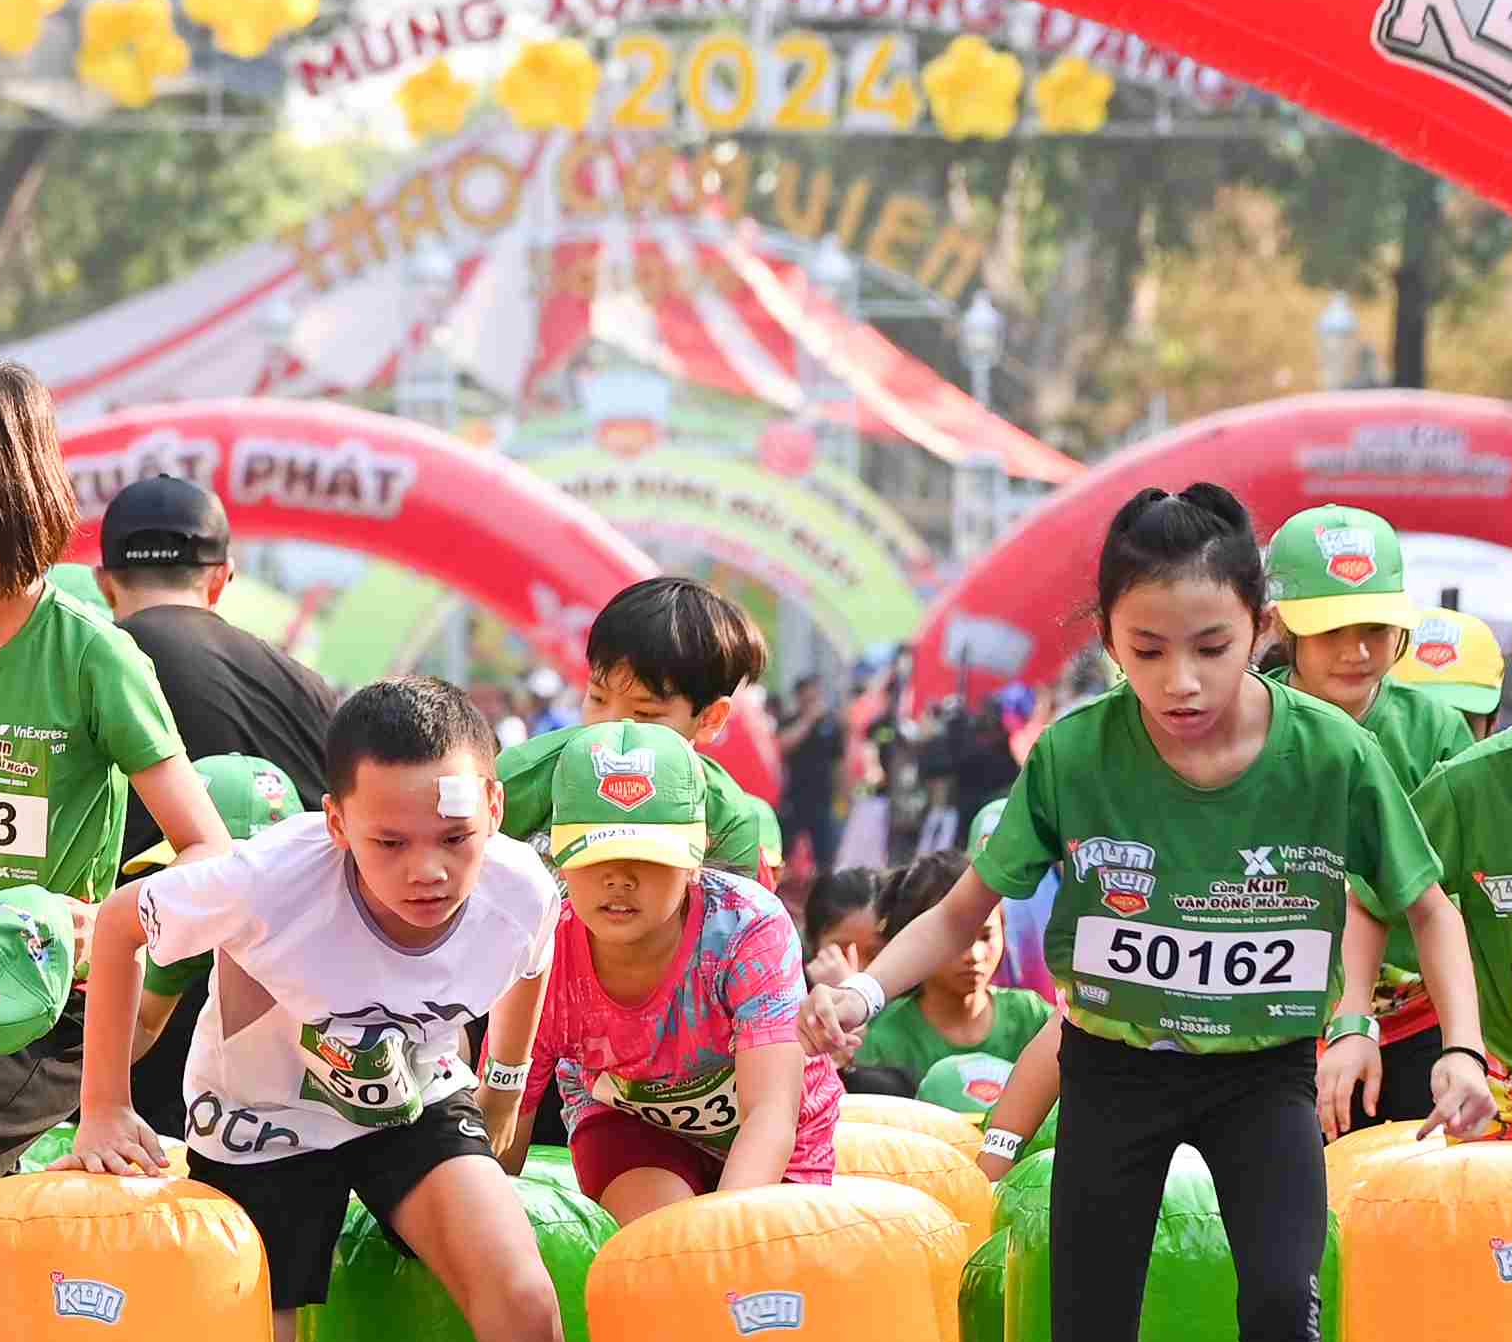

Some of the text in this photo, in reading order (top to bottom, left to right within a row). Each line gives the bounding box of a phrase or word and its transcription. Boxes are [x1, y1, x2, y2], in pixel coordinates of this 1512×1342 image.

[613, 33, 919, 131] 2024
[242, 451, 400, 504] PHÁT
[7, 761, 38, 777] NGÀY
[1175, 897, 1206, 911] VẬN
[1210, 897, 1252, 912] ĐỘNG
[1282, 896, 1318, 909] NGÀY
[1210, 877, 1288, 897] Cùng Kun
[1107, 927, 1296, 987] 50162
